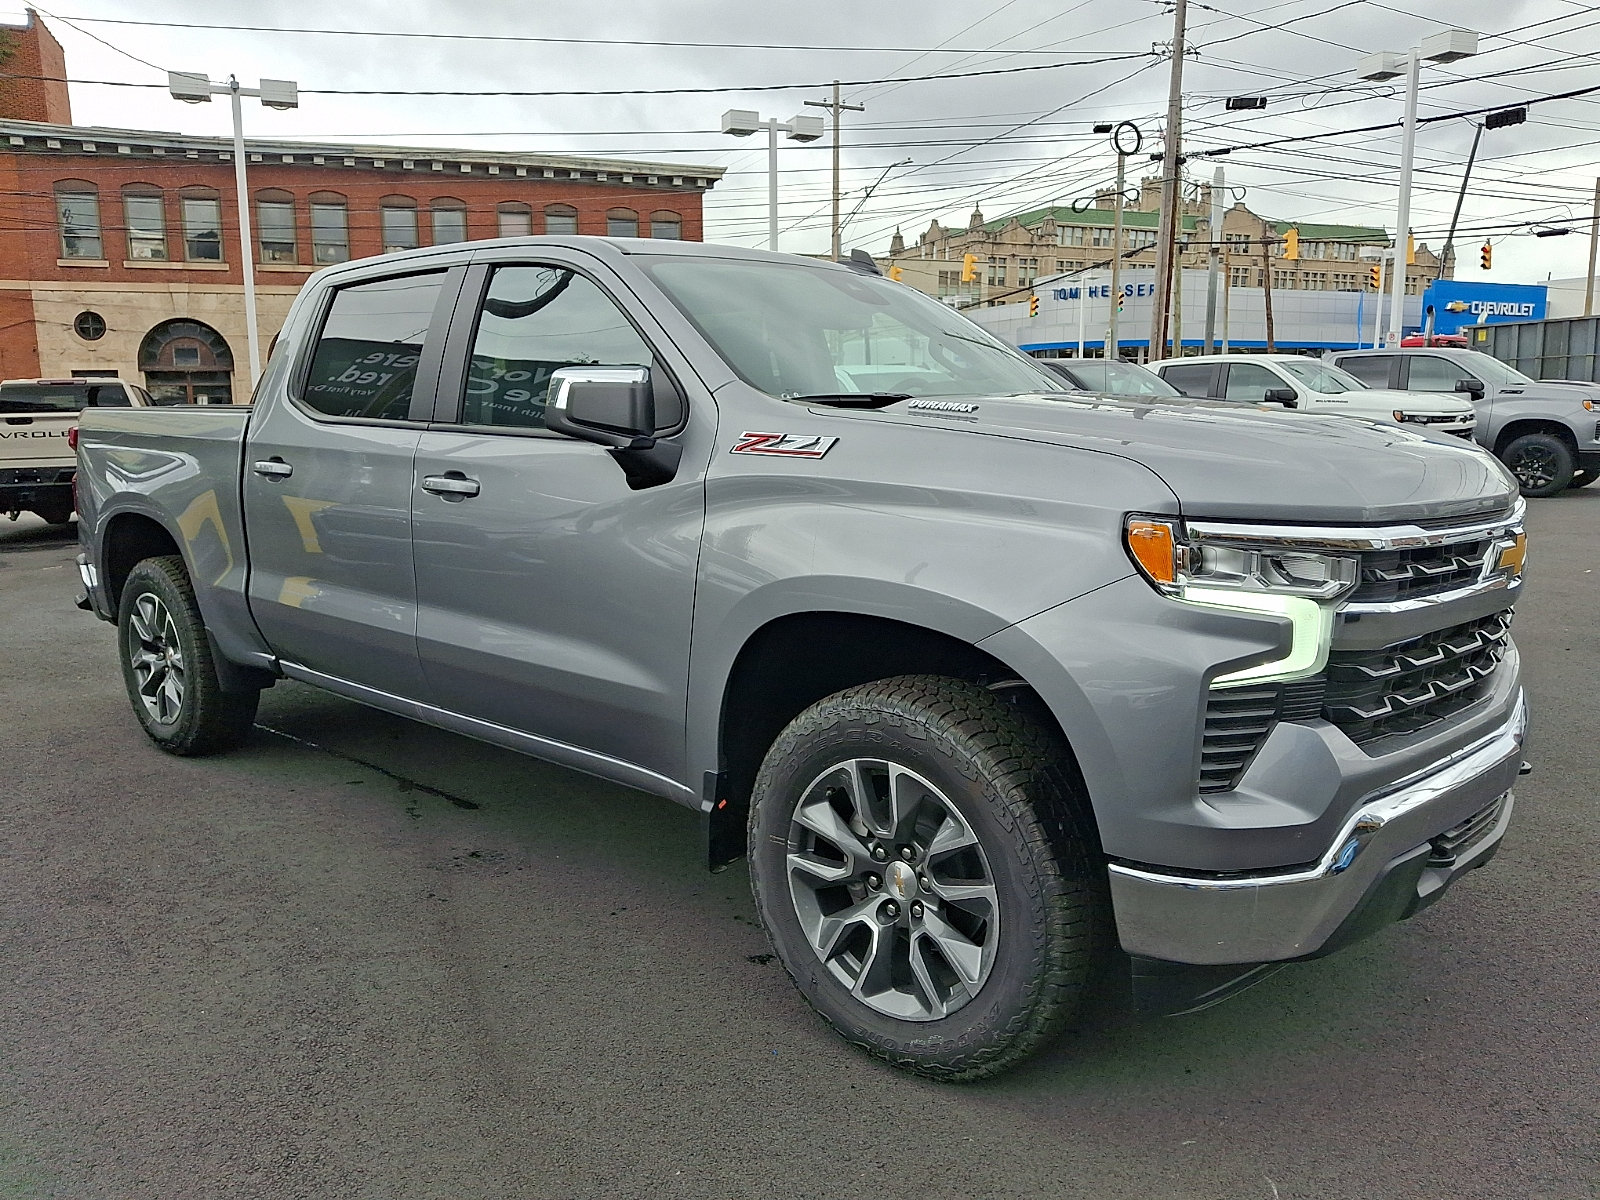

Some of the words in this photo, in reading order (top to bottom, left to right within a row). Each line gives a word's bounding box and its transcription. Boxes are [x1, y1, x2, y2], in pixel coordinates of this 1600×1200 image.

[1053, 287, 1081, 300] TOM
[1088, 284, 1155, 298] HESER
[1471, 301, 1536, 316] CHEVROLET
[908, 400, 977, 413] DURAMAX
[0, 431, 70, 439] VROLE
[731, 431, 840, 460] Z71
